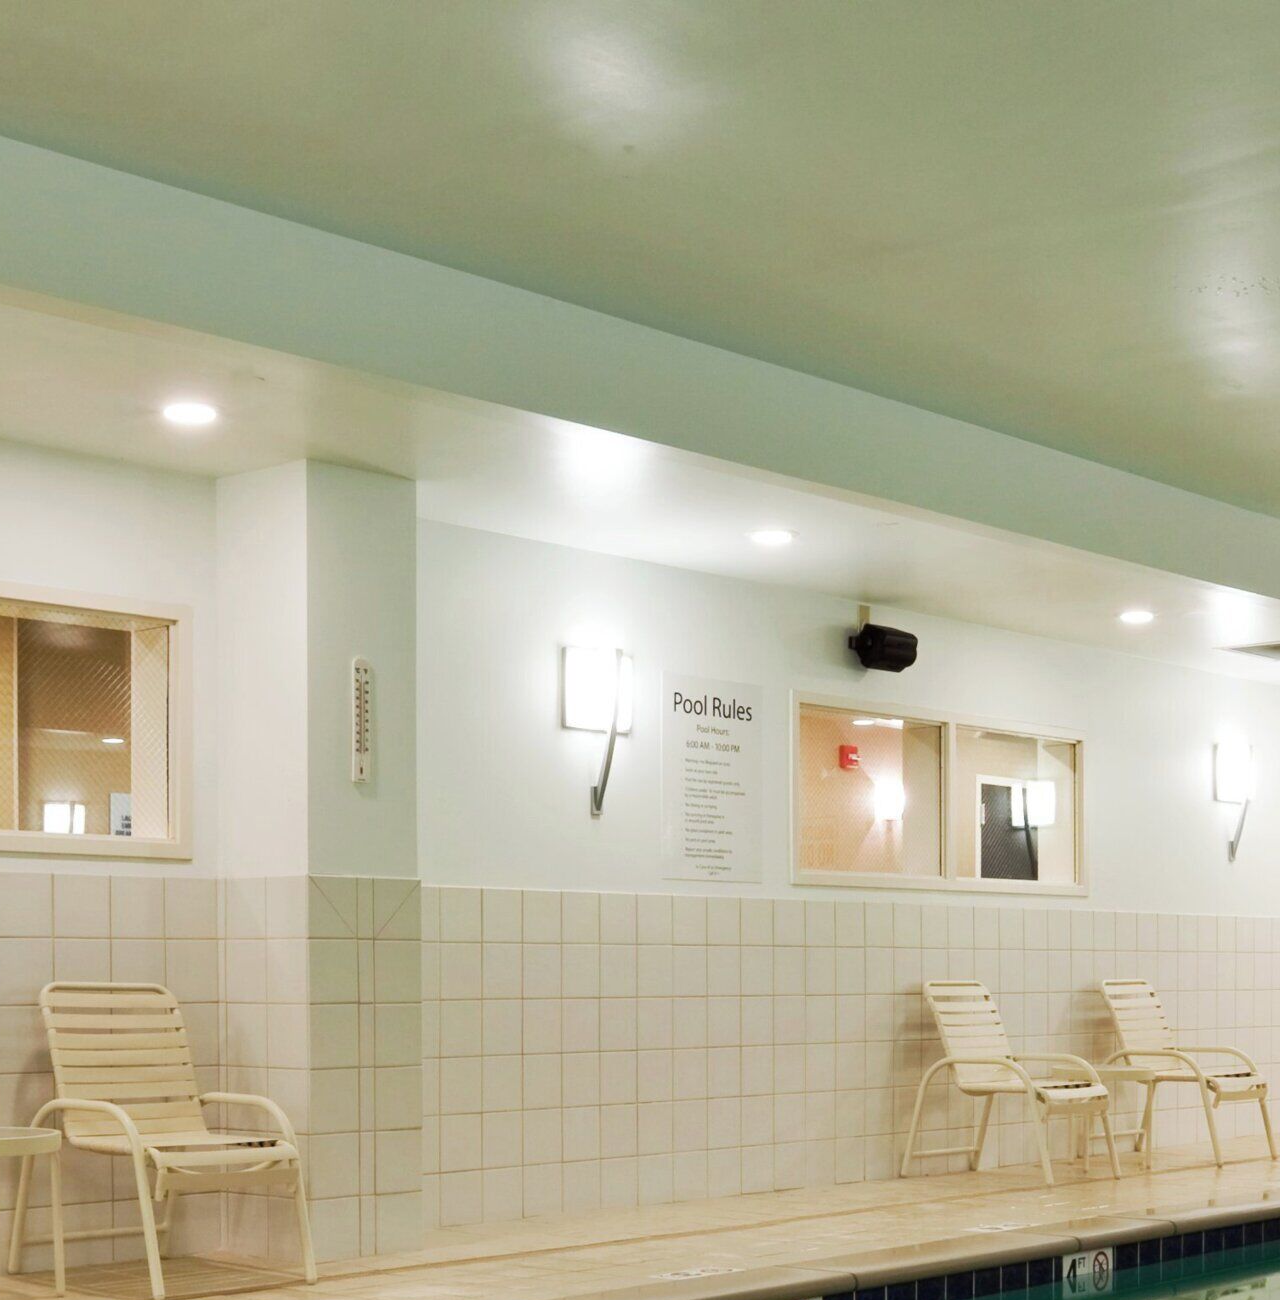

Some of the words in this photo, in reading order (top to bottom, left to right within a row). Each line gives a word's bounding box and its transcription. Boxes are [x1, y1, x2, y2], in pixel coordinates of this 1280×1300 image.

[674, 692, 707, 716] Pool
[713, 697, 752, 721] Rules
[1078, 1256, 1086, 1268] FT
